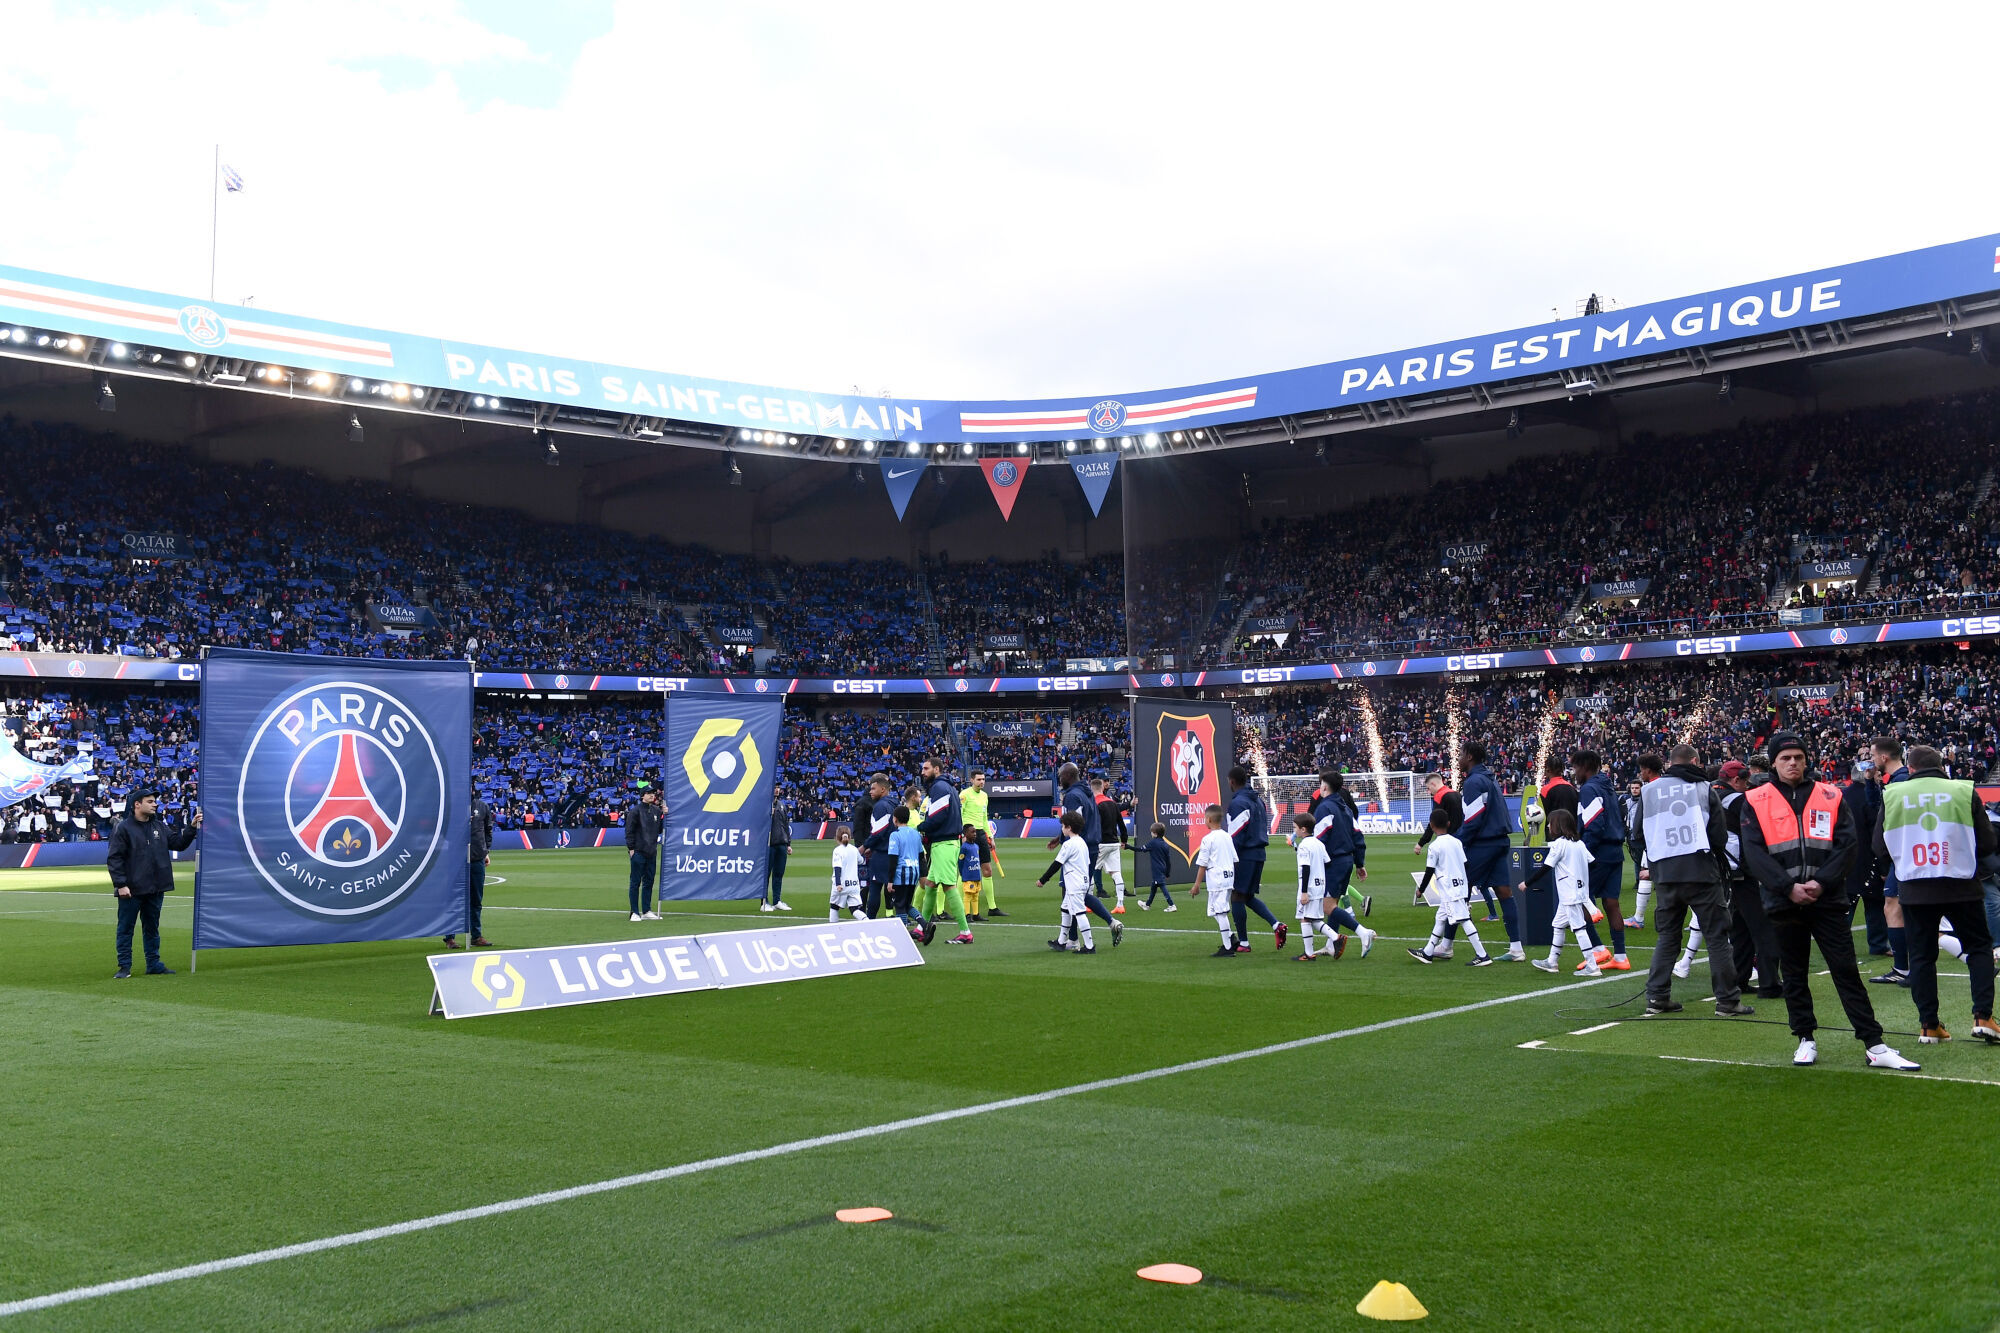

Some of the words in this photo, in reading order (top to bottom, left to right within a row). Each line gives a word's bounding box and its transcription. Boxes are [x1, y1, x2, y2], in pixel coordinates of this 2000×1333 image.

[1340, 348, 1475, 395] PARIS
[1490, 329, 1581, 370] EST
[1593, 278, 1842, 352] MAGIQUE
[446, 353, 581, 396] PARIS
[601, 376, 923, 431] SAINT-GERMAIN
[1095, 401, 1121, 411] PARIS
[1076, 462, 1110, 473] QATAR
[123, 534, 176, 549] QATAR
[1814, 561, 1851, 574] QATAR
[1604, 581, 1636, 592] QATAR
[1258, 618, 1286, 626] QATAR
[1942, 616, 2000, 637] C'ES
[722, 628, 753, 637] QATAR
[990, 636, 1018, 644] QATAR
[1676, 636, 1741, 656] C'EST
[1446, 653, 1504, 671] C'EST
[1241, 667, 1295, 683] C'EST
[637, 677, 689, 691] C'EST
[833, 680, 886, 693] C'EST
[1037, 676, 1091, 691] C'EST
[1789, 687, 1828, 699] QATAR
[1575, 698, 1608, 709] QATAR
[277, 694, 411, 748] PARIS
[993, 723, 1022, 732] QAAR
[1657, 783, 1696, 799] LFP
[1903, 792, 1952, 809] LFP
[1161, 803, 1184, 815] STADE
[1185, 803, 1215, 815] RENNA
[1665, 825, 1693, 847] 50
[1912, 842, 1941, 866] 03
[277, 851, 327, 890] SAINT
[341, 848, 412, 894] GERMAIN
[676, 855, 714, 873] Uber
[717, 855, 755, 873] Eats
[548, 945, 701, 994] LIGUE
[704, 943, 729, 977] 1
[736, 939, 820, 975] Uber
[817, 930, 897, 966] Eats
